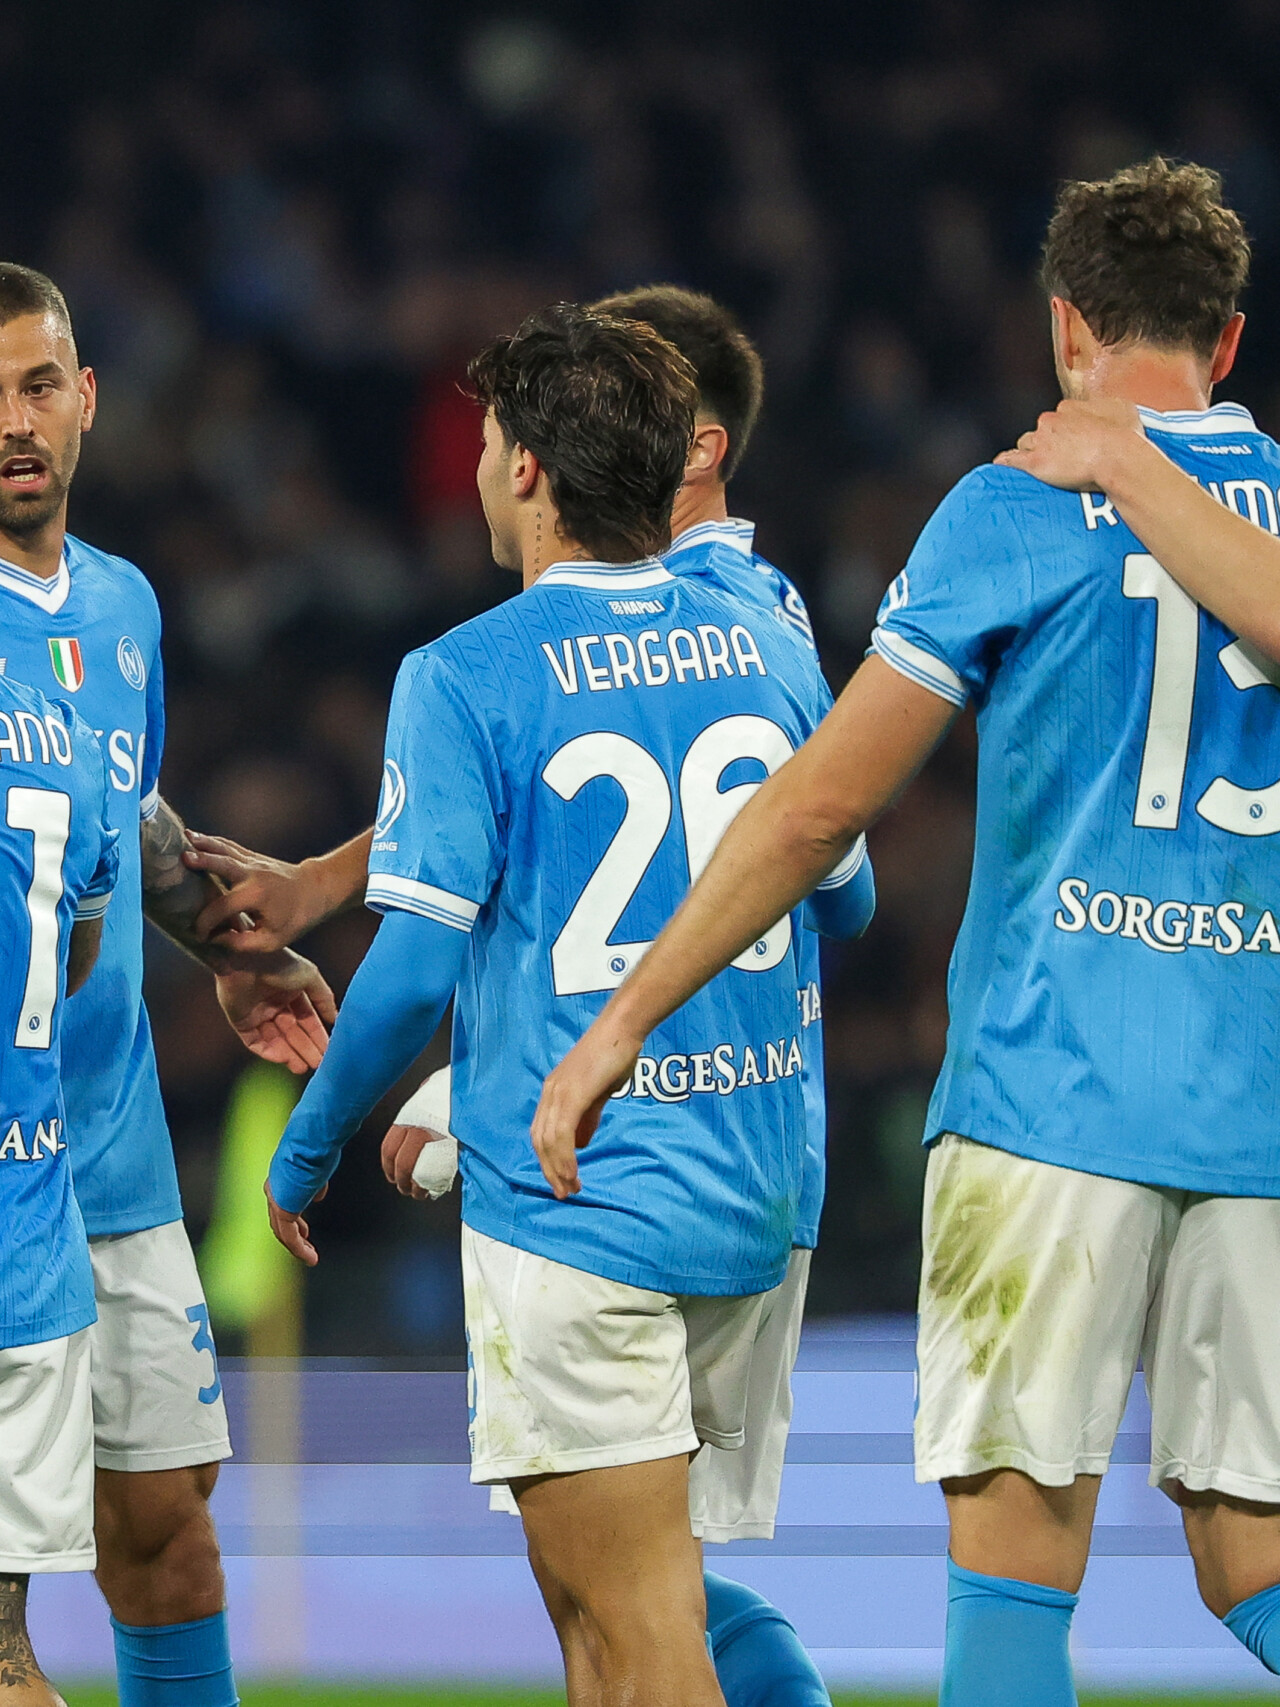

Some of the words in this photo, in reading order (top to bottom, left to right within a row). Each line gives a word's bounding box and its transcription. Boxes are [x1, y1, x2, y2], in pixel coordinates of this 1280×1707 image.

[619, 600, 666, 615] NAPOLI
[541, 624, 767, 695] VERGARA
[541, 714, 797, 997] 26
[1054, 876, 1280, 956] SORGESA
[609, 1035, 804, 1103] RGESANA
